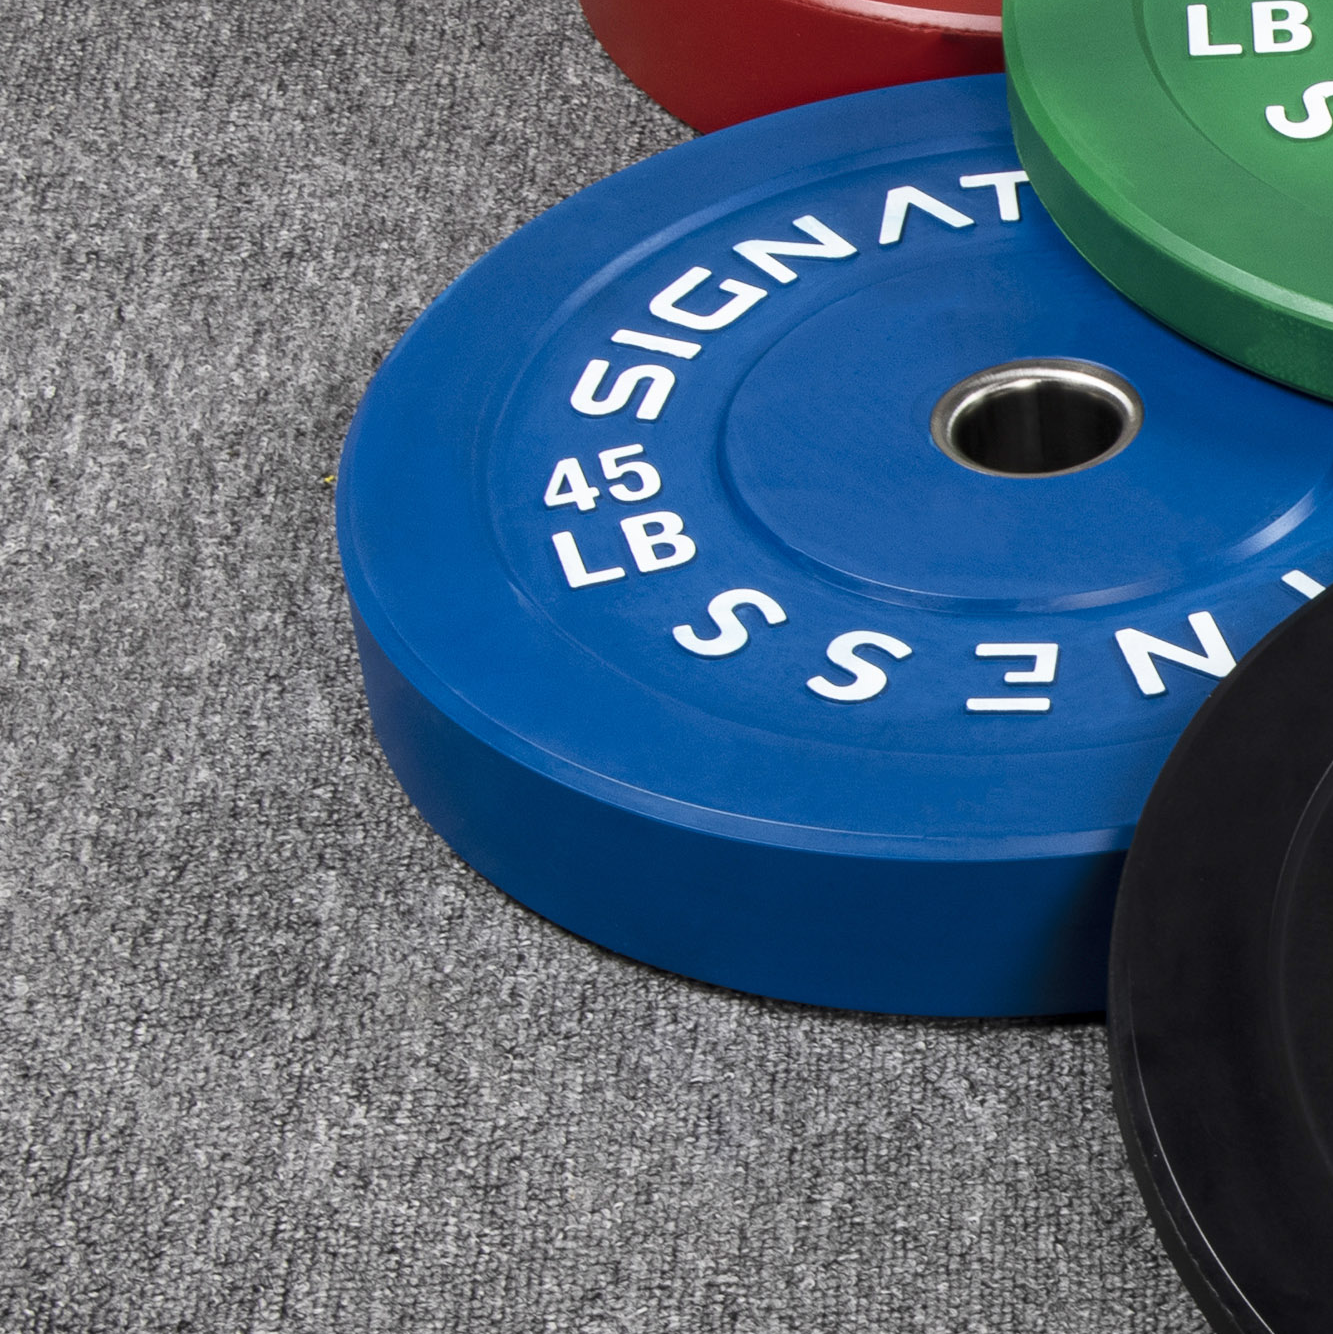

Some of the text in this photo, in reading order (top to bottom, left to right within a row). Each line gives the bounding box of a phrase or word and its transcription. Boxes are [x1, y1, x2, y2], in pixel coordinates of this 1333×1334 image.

[1186, 0, 1314, 57] LB
[570, 169, 1032, 421] SIGNAT
[544, 442, 662, 512] 45
[552, 510, 696, 589] LB
